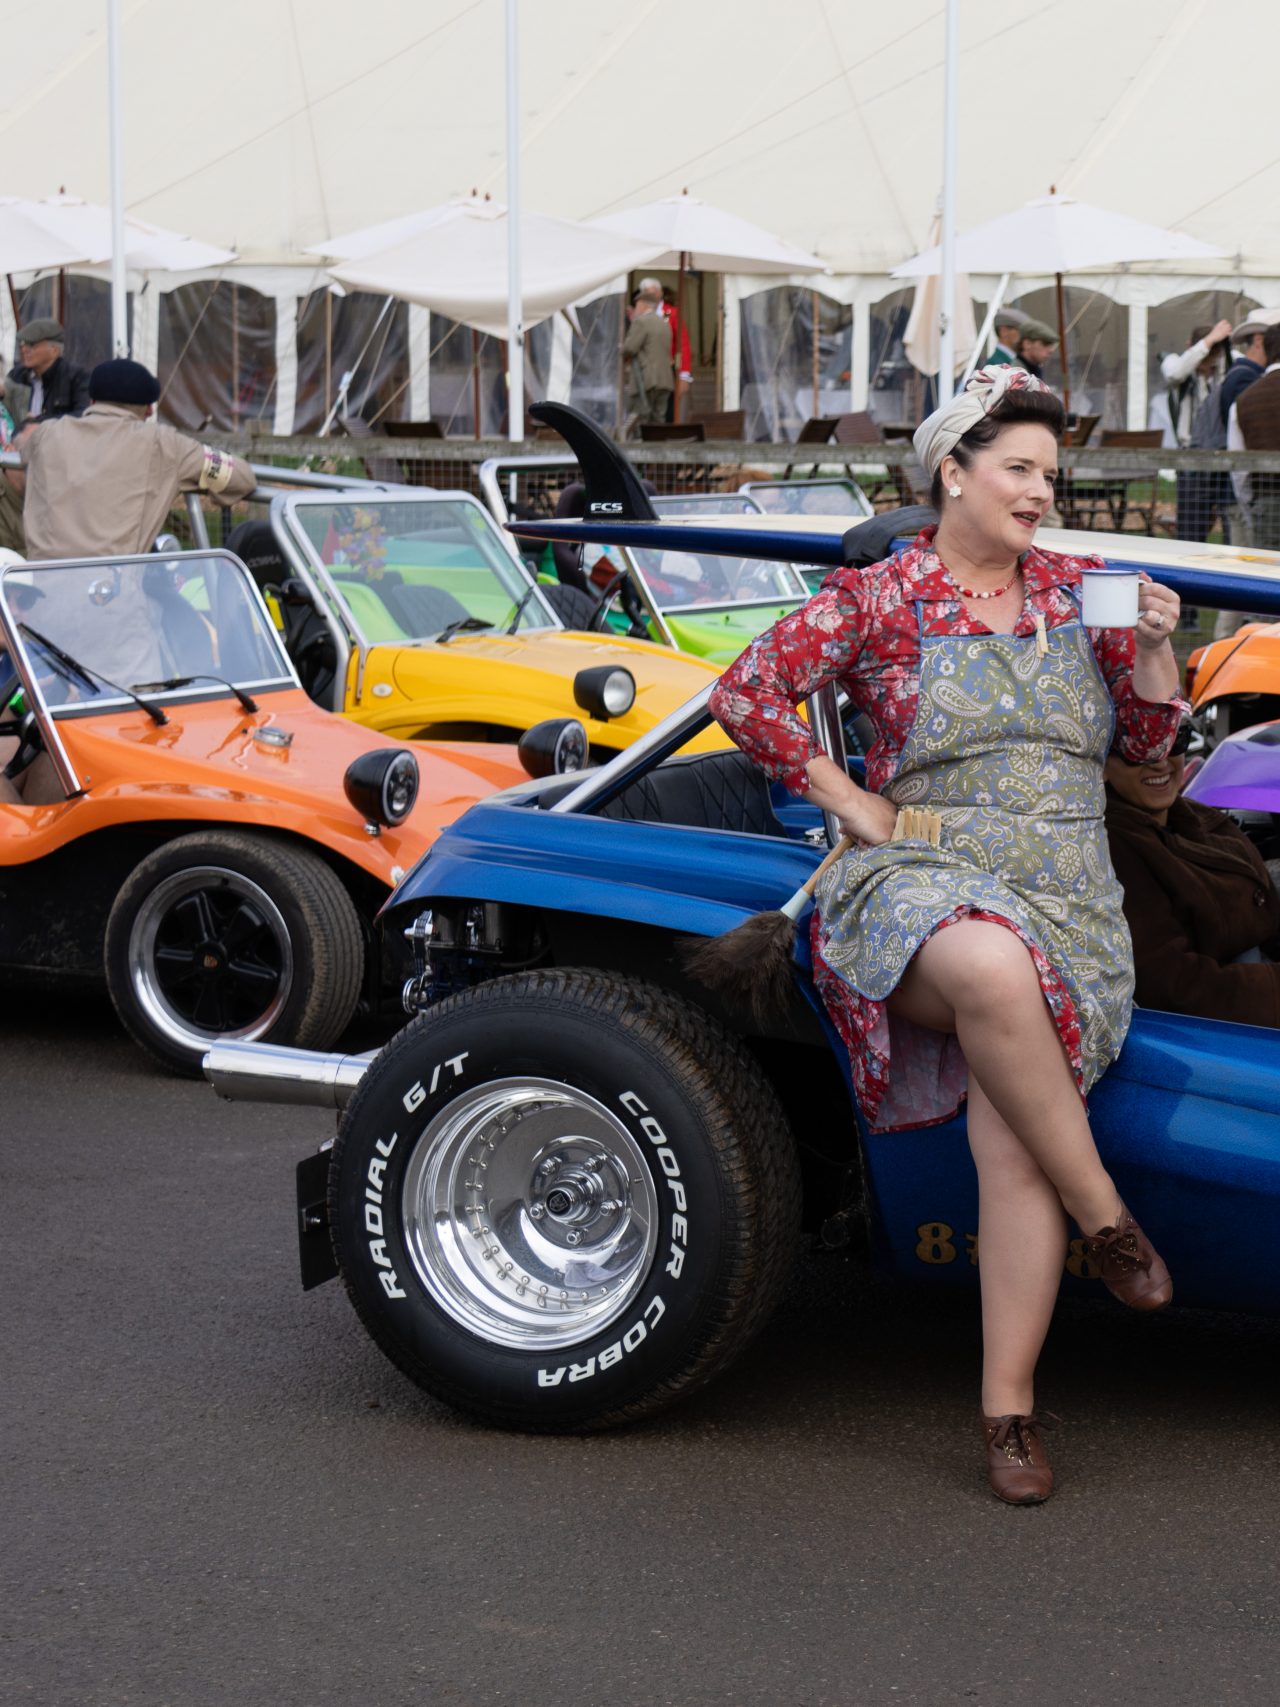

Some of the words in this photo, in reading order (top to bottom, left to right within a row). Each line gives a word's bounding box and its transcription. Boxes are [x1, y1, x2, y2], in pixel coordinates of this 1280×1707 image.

[590, 502, 623, 512] FCS
[402, 1051, 469, 1113] G/T
[365, 1132, 407, 1298] RADIAL
[618, 1090, 688, 1280] COOPER
[537, 1295, 666, 1388] COBRA
